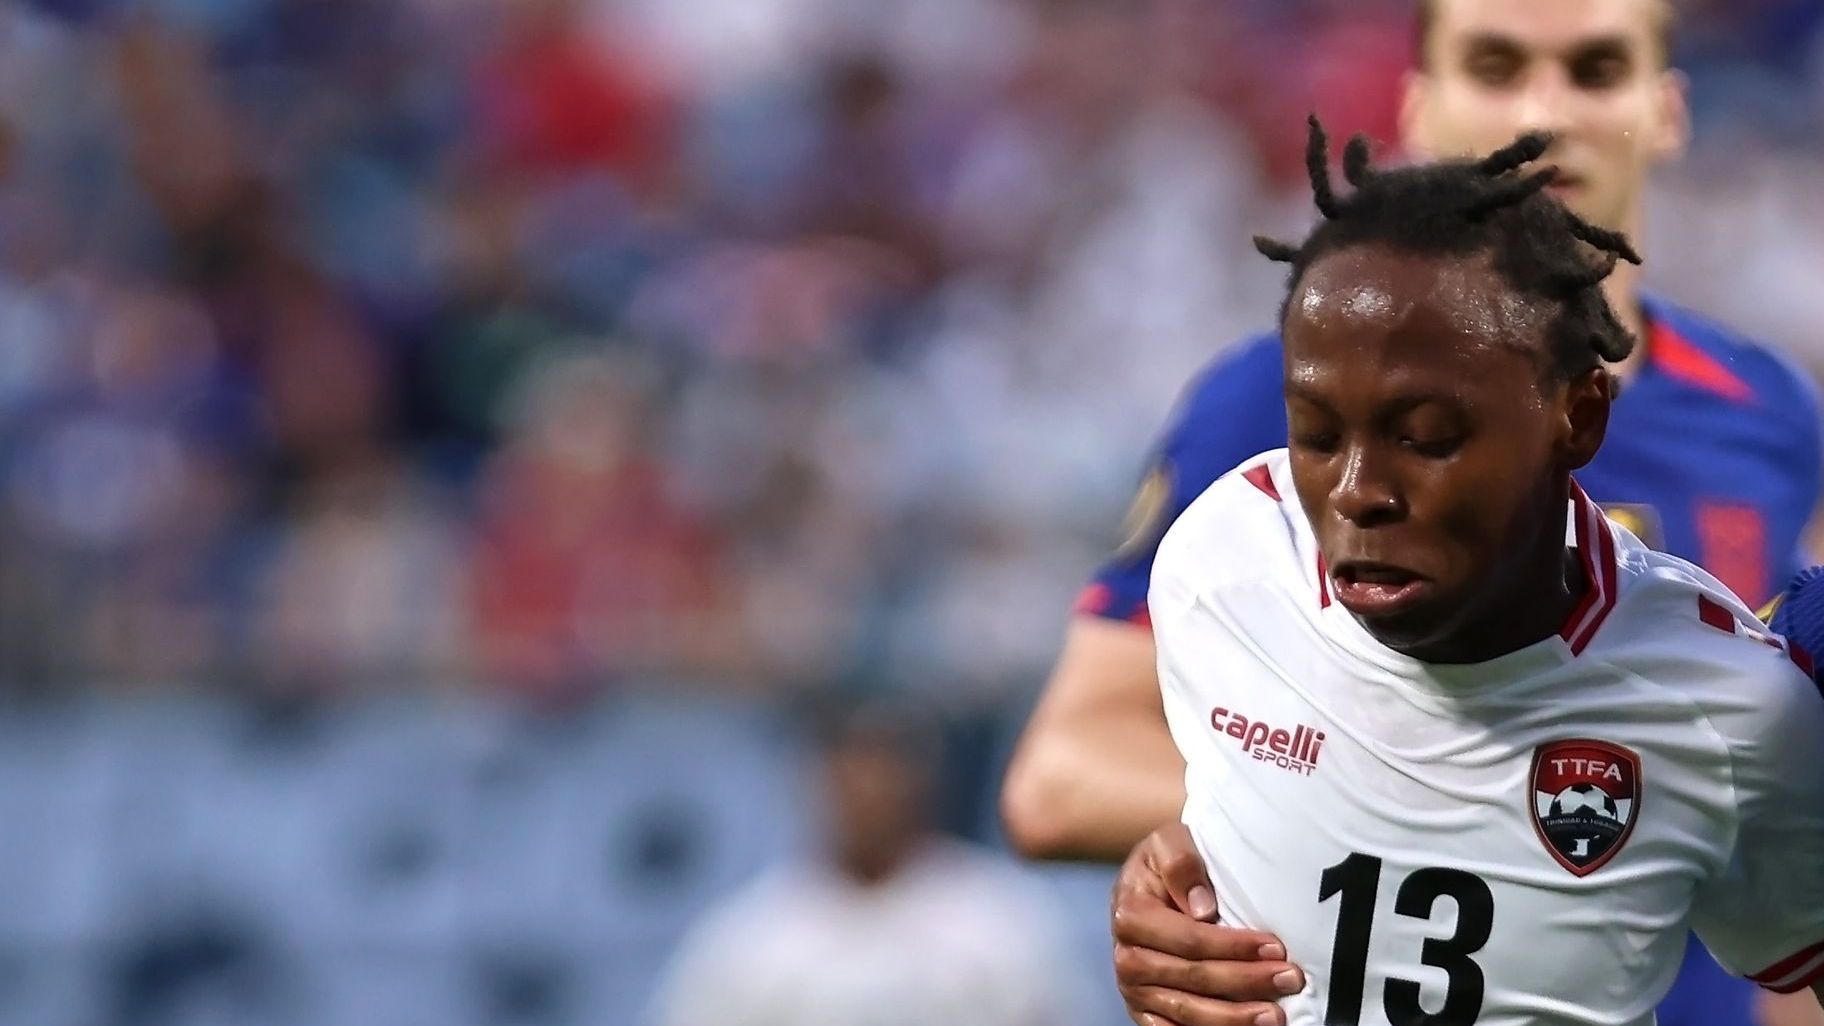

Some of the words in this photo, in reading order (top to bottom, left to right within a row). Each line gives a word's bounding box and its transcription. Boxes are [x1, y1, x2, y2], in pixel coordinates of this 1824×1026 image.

[1210, 706, 1326, 765] capelli
[1252, 748, 1317, 777] SPORT
[1550, 758, 1622, 782] TTFA
